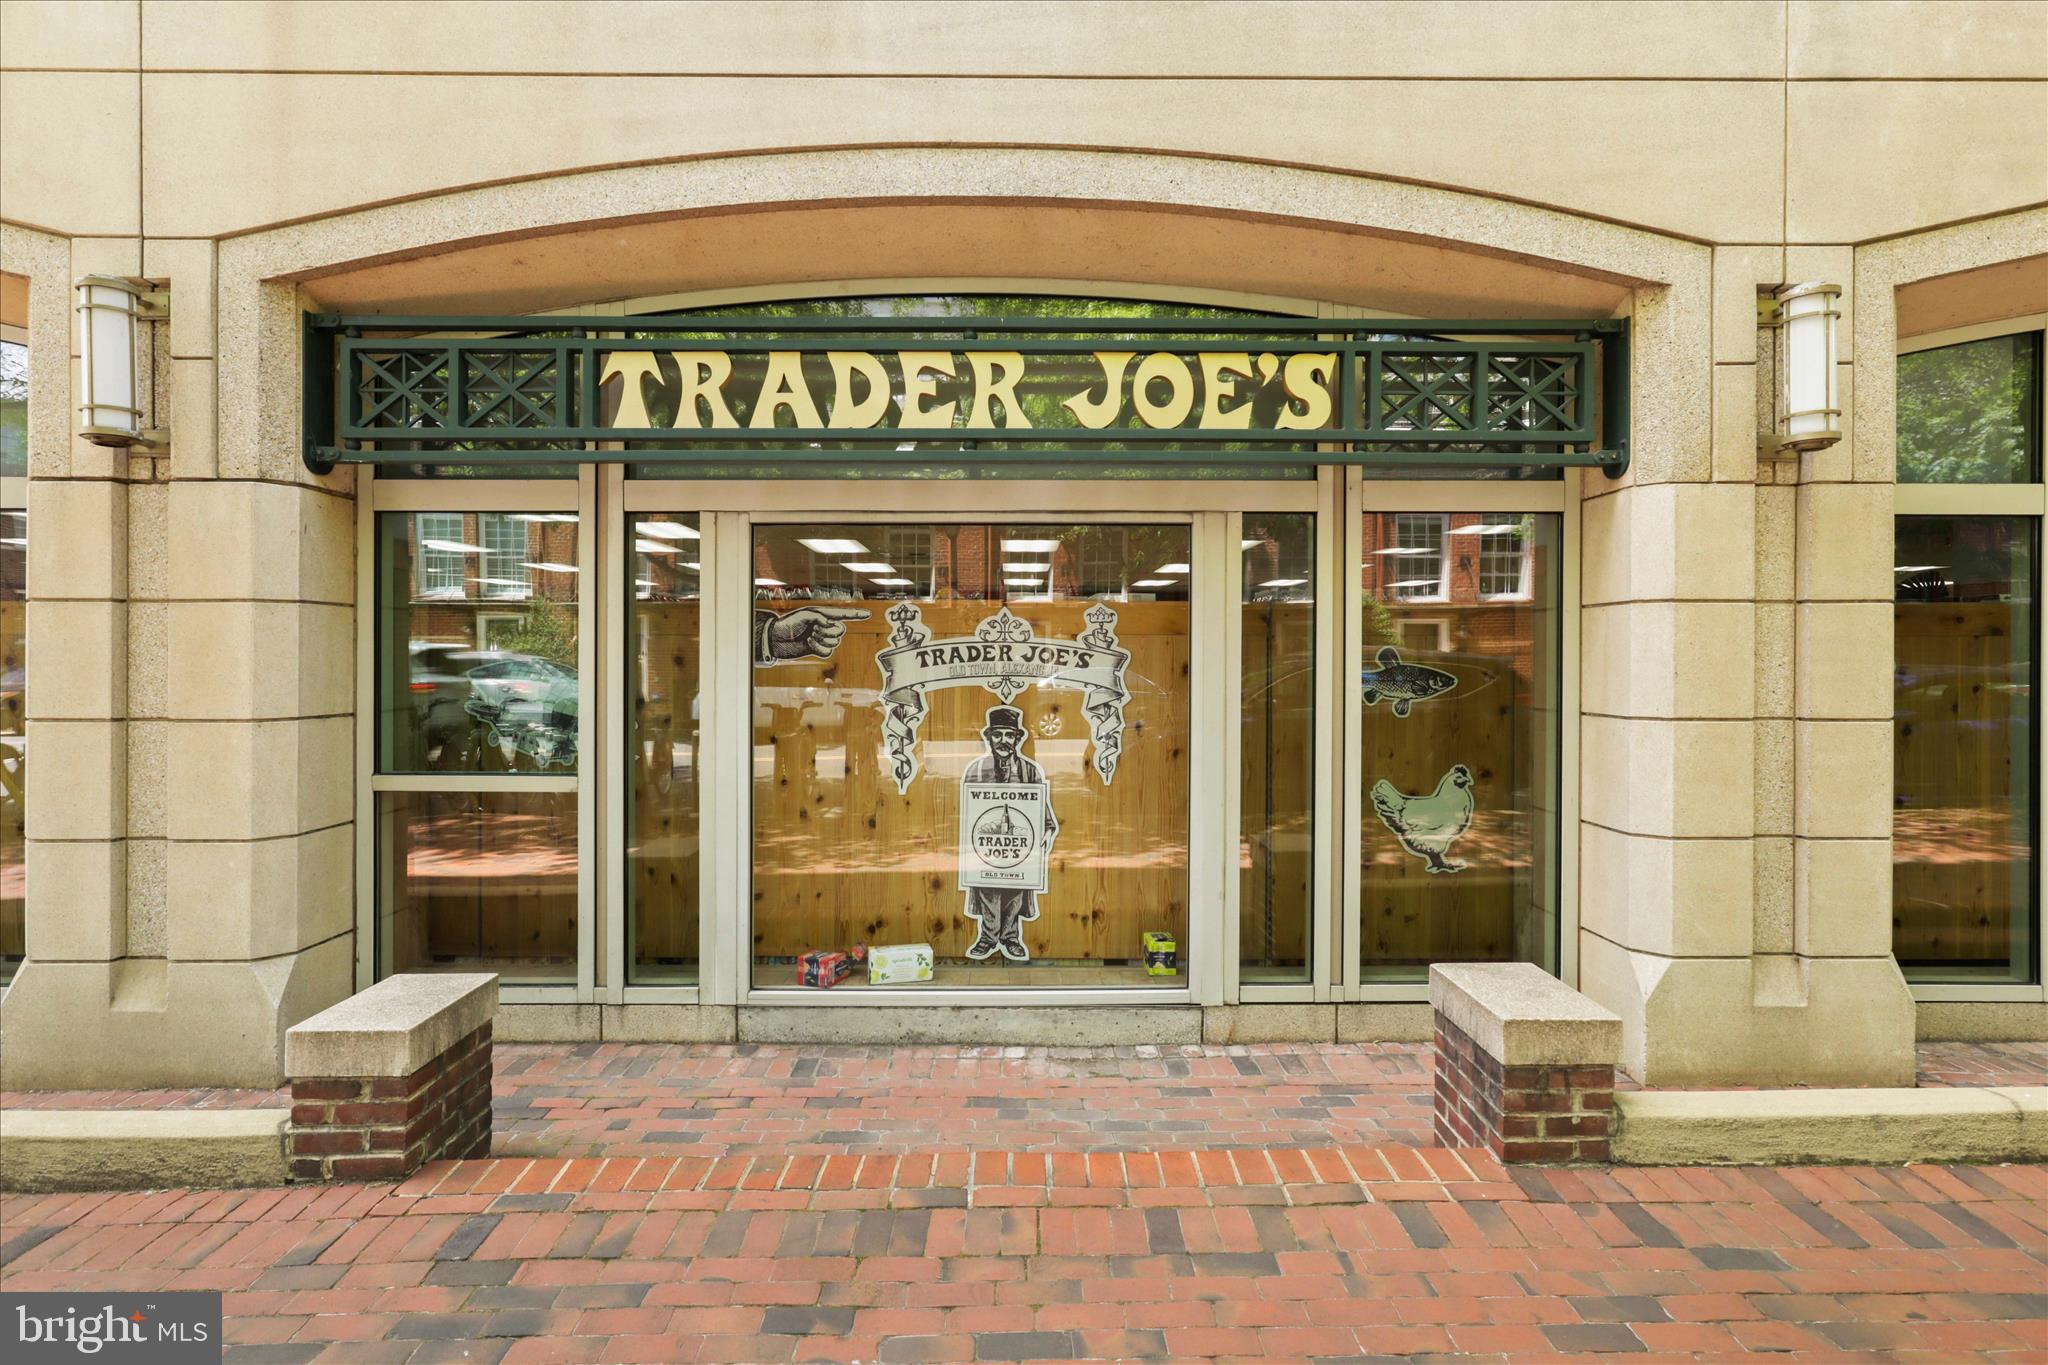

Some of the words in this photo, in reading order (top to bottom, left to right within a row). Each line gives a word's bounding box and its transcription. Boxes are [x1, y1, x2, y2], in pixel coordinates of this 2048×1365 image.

[598, 351, 1033, 430] TRADER
[1062, 351, 1338, 430] JOE'S
[915, 644, 1014, 669] TRADER
[1020, 646, 1095, 669] JOE'S
[949, 664, 967, 677] OLD
[970, 791, 1039, 801] WELCOME
[978, 836, 1028, 848] TRADER
[985, 848, 1021, 859] JOE'S
